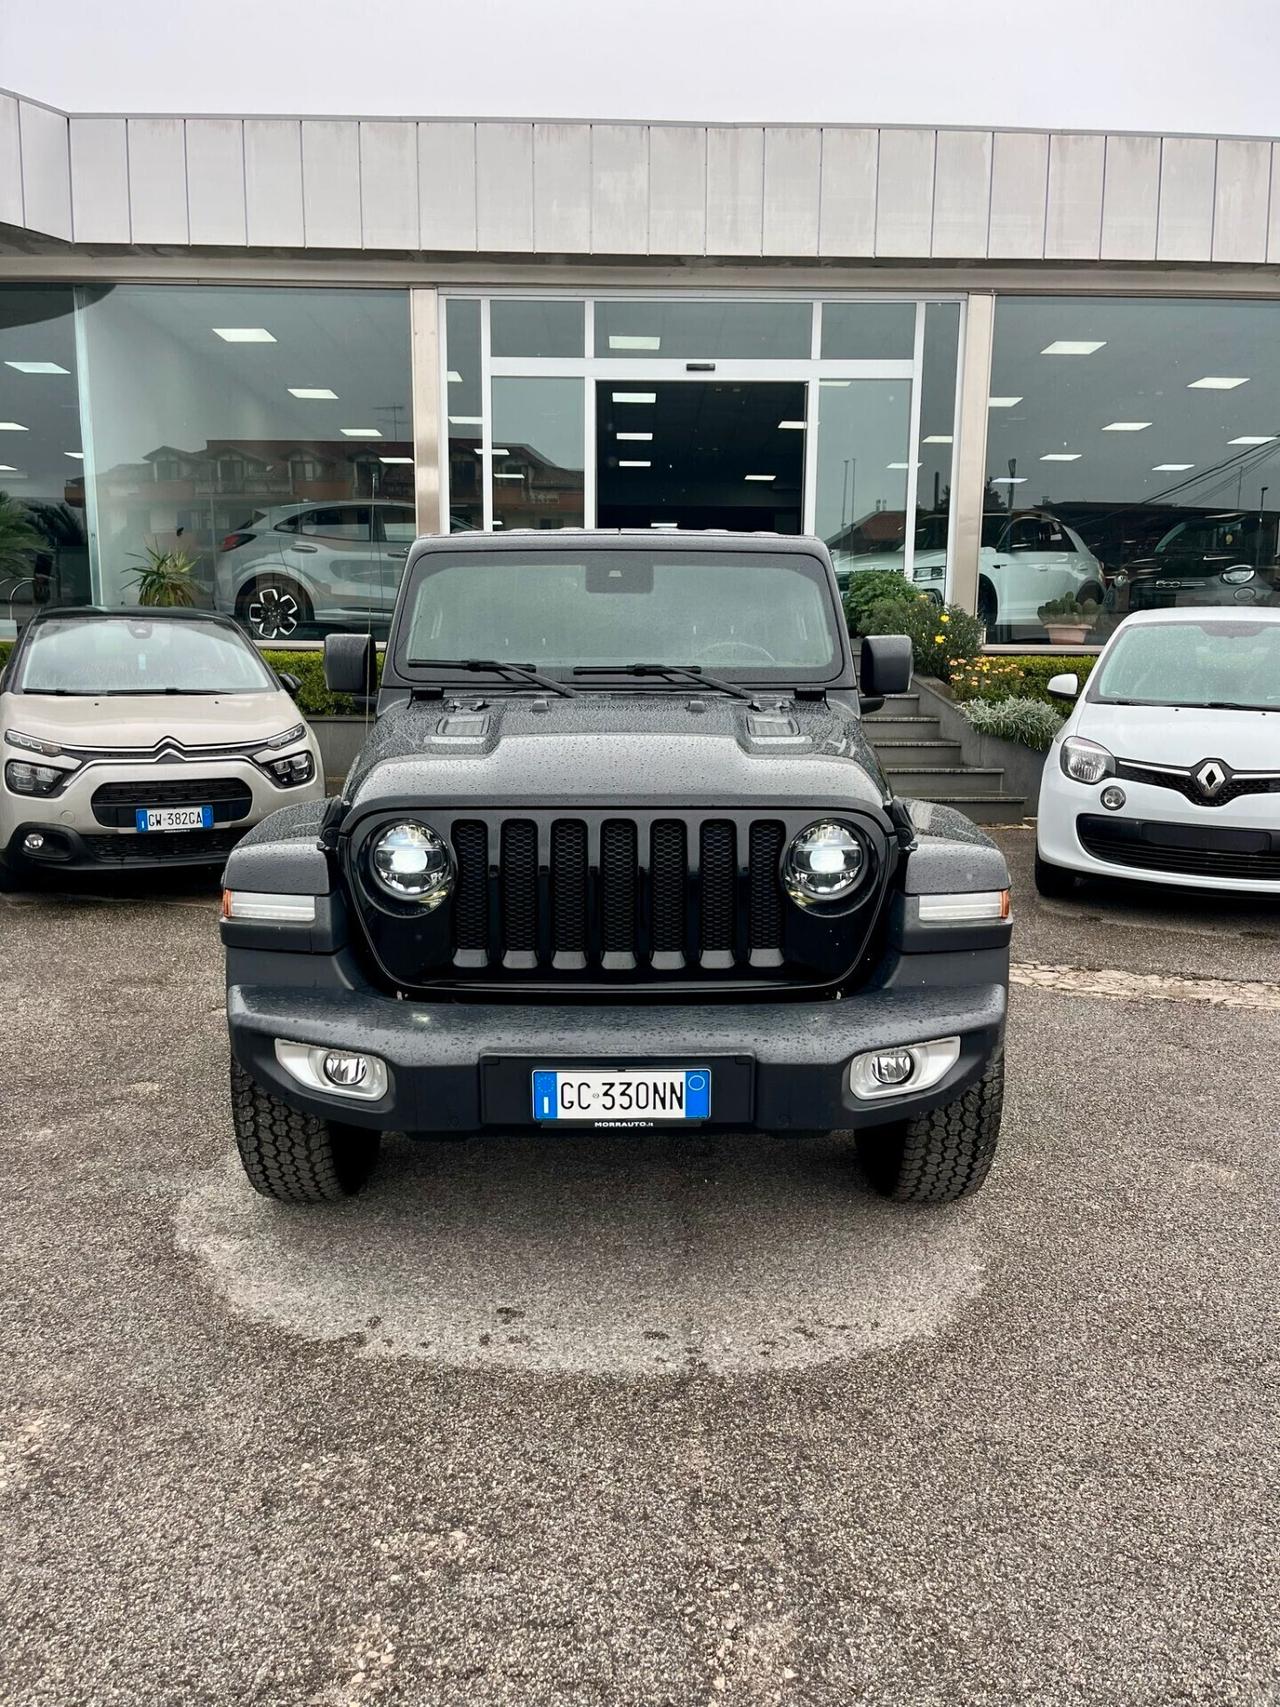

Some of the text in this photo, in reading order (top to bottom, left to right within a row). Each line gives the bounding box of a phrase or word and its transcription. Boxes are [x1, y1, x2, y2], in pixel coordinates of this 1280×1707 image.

[543, 1082, 684, 1114] I GC 330NN
